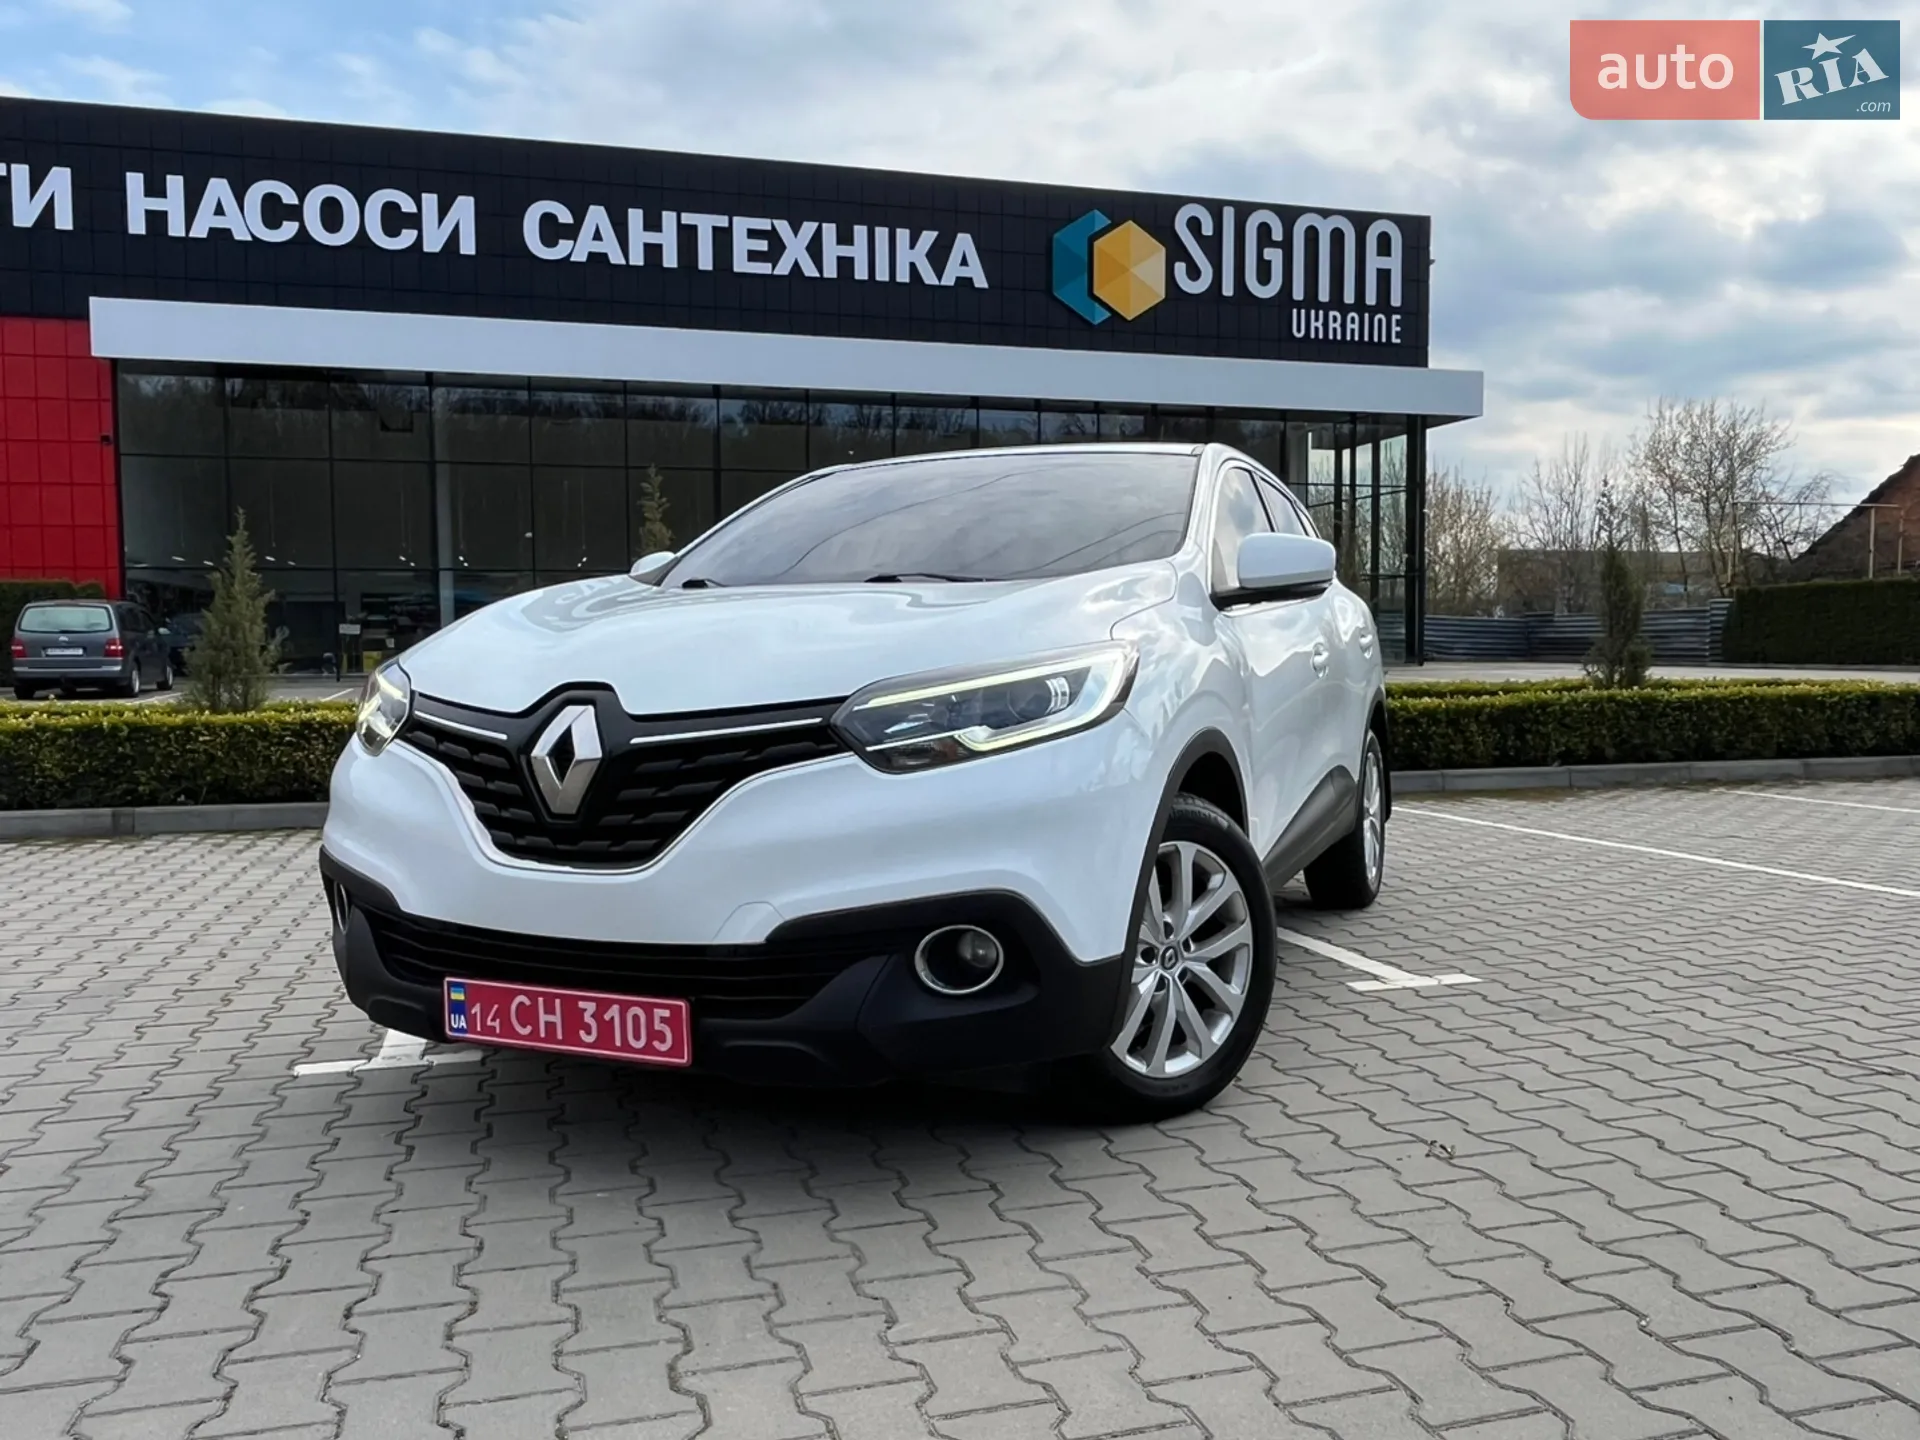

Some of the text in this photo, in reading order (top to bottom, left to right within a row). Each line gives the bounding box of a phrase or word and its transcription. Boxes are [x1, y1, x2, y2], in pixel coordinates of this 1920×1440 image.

[126, 171, 476, 255] НАСОСИ
[523, 200, 988, 289] САНТЕХНІКА
[1174, 203, 1403, 307] SIGMA
[1292, 308, 1402, 344] UKRAINE
[450, 1014, 467, 1029] UA
[578, 1001, 673, 1052] 3105
